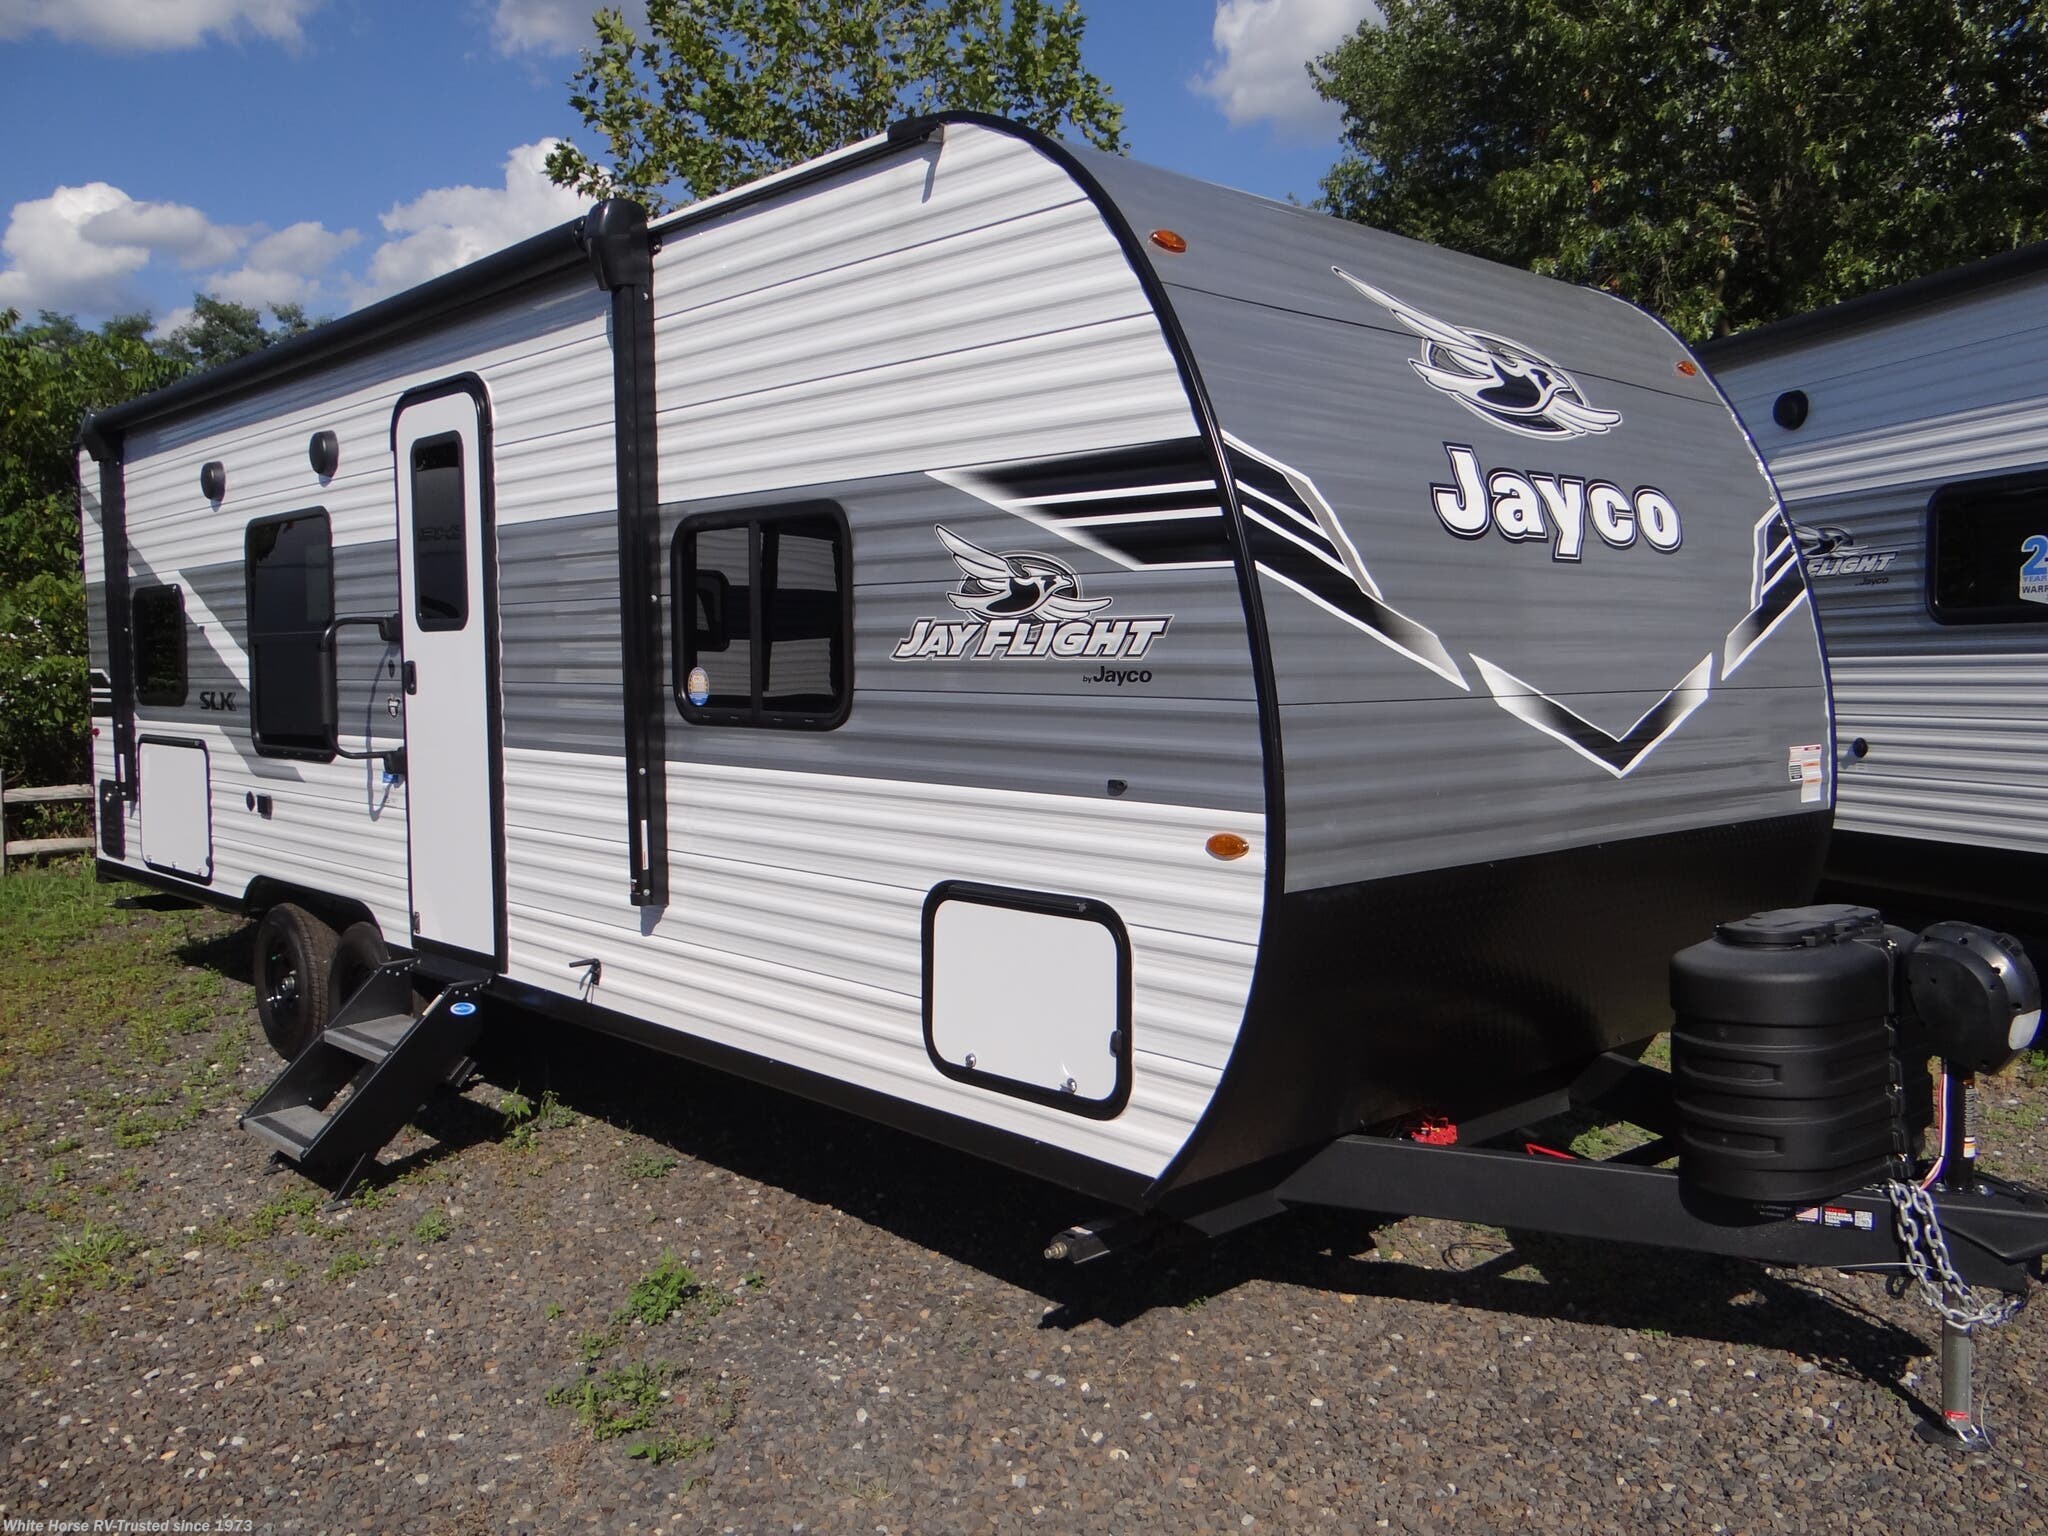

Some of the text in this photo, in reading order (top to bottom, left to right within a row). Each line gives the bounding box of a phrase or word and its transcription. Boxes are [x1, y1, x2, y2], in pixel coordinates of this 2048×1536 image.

[1430, 438, 1682, 563] Jayco
[890, 614, 1174, 661] JAY FLIGHT
[1082, 666, 1153, 686] by Jayco
[200, 691, 237, 711] SLK
